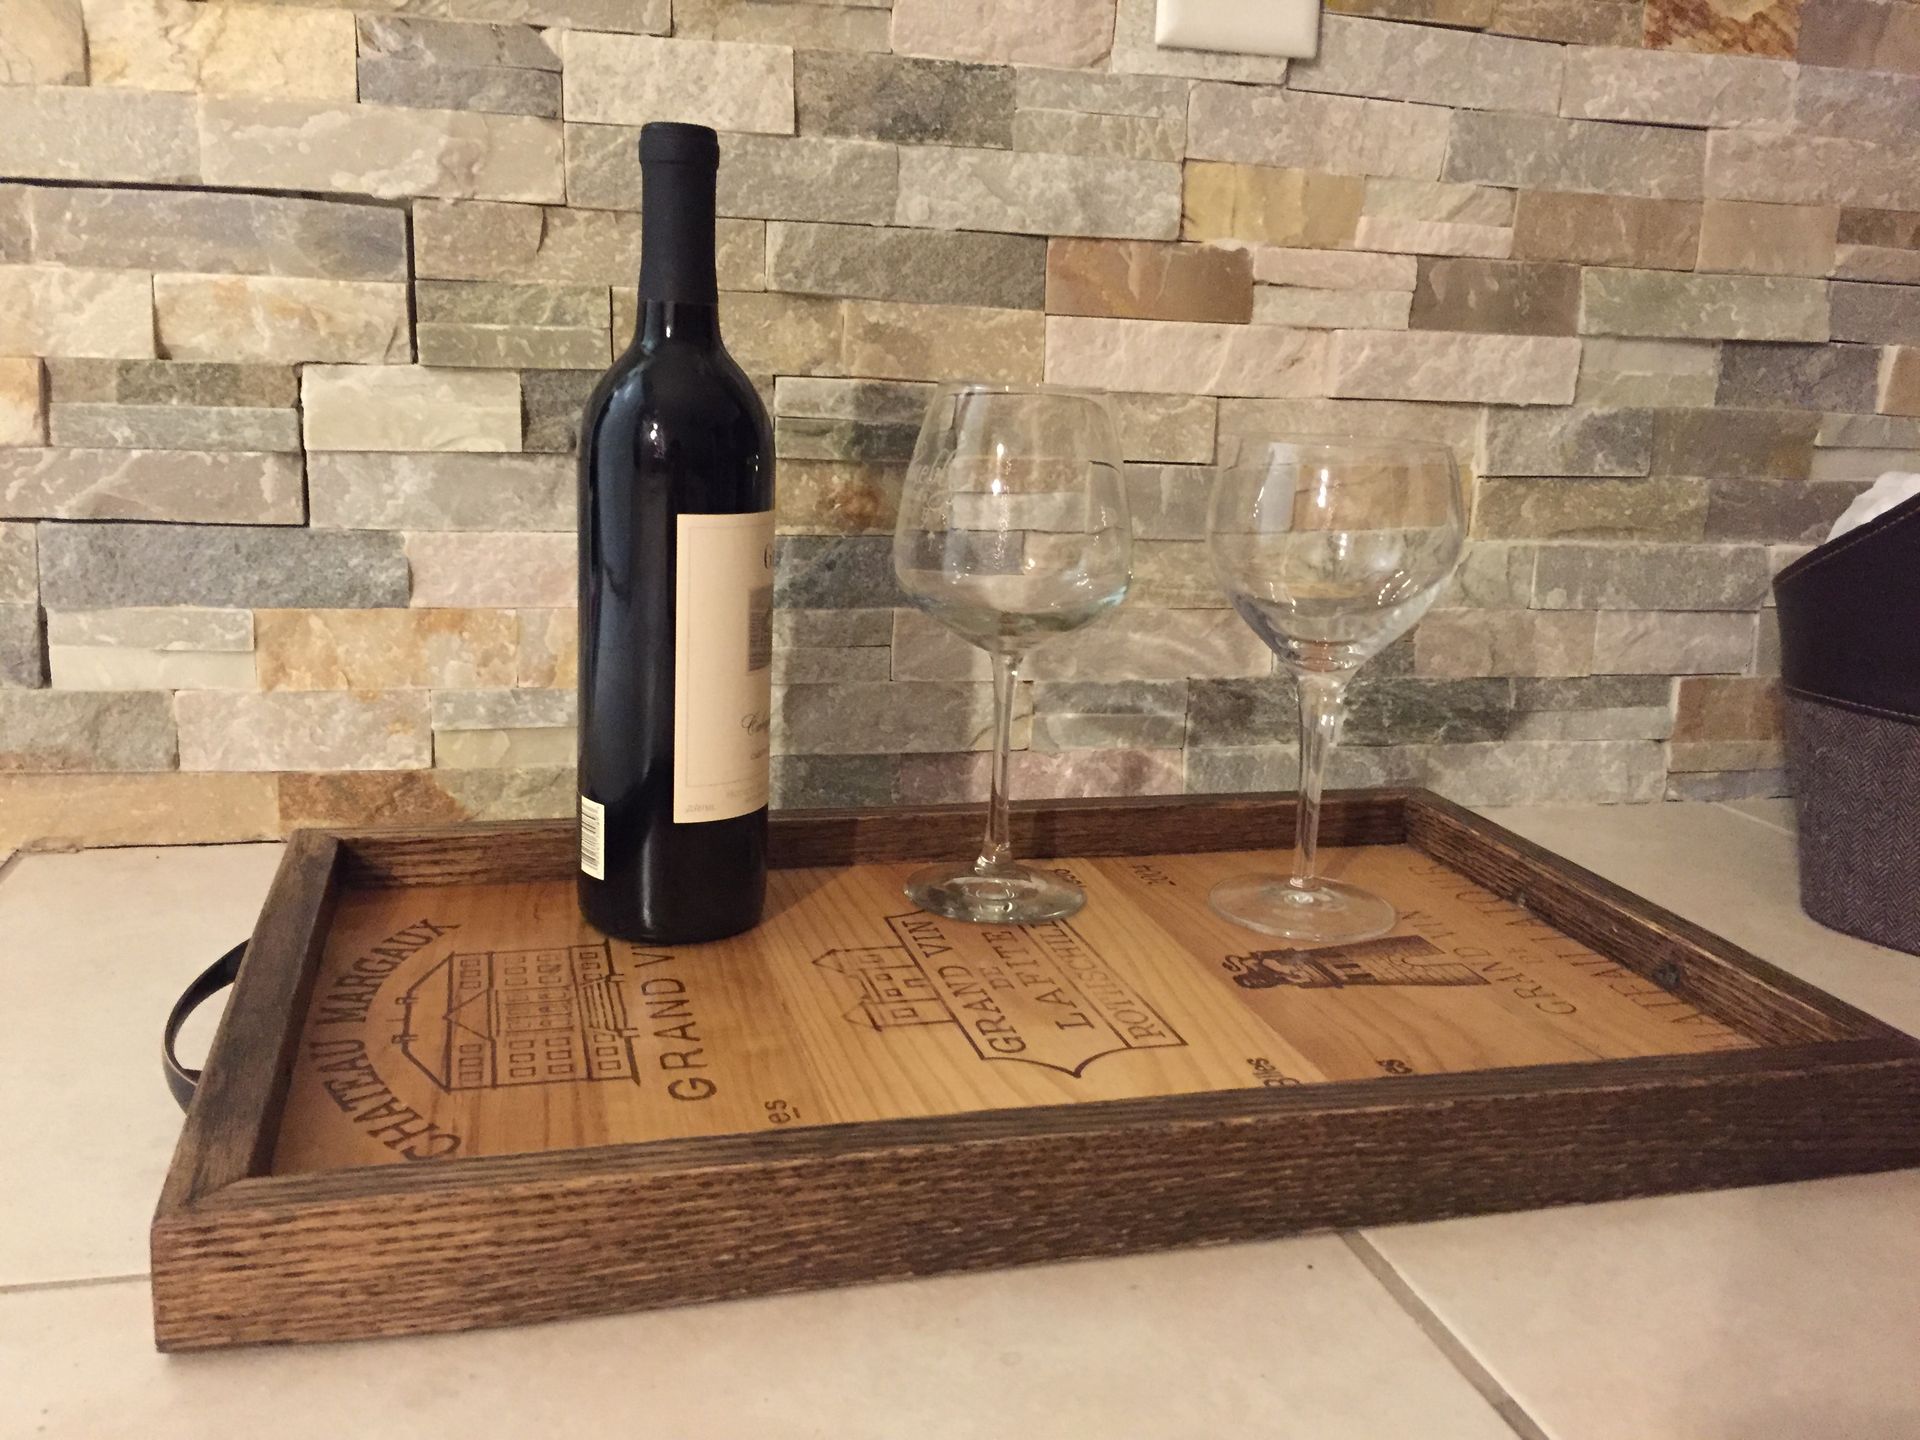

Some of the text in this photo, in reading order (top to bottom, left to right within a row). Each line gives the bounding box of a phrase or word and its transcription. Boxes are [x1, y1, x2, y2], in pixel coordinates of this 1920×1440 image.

[631, 945, 717, 1102] GRAND VI
[902, 918, 1027, 1055] GRAND VIN
[980, 964, 1016, 991] DE
[982, 931, 1095, 1031] LAFITE
[1453, 946, 1577, 1015] GRAND
[1556, 953, 1757, 1050] HATEAU
[308, 918, 462, 1162] CHATEAU MARGAUX
[764, 1099, 793, 1125] es
